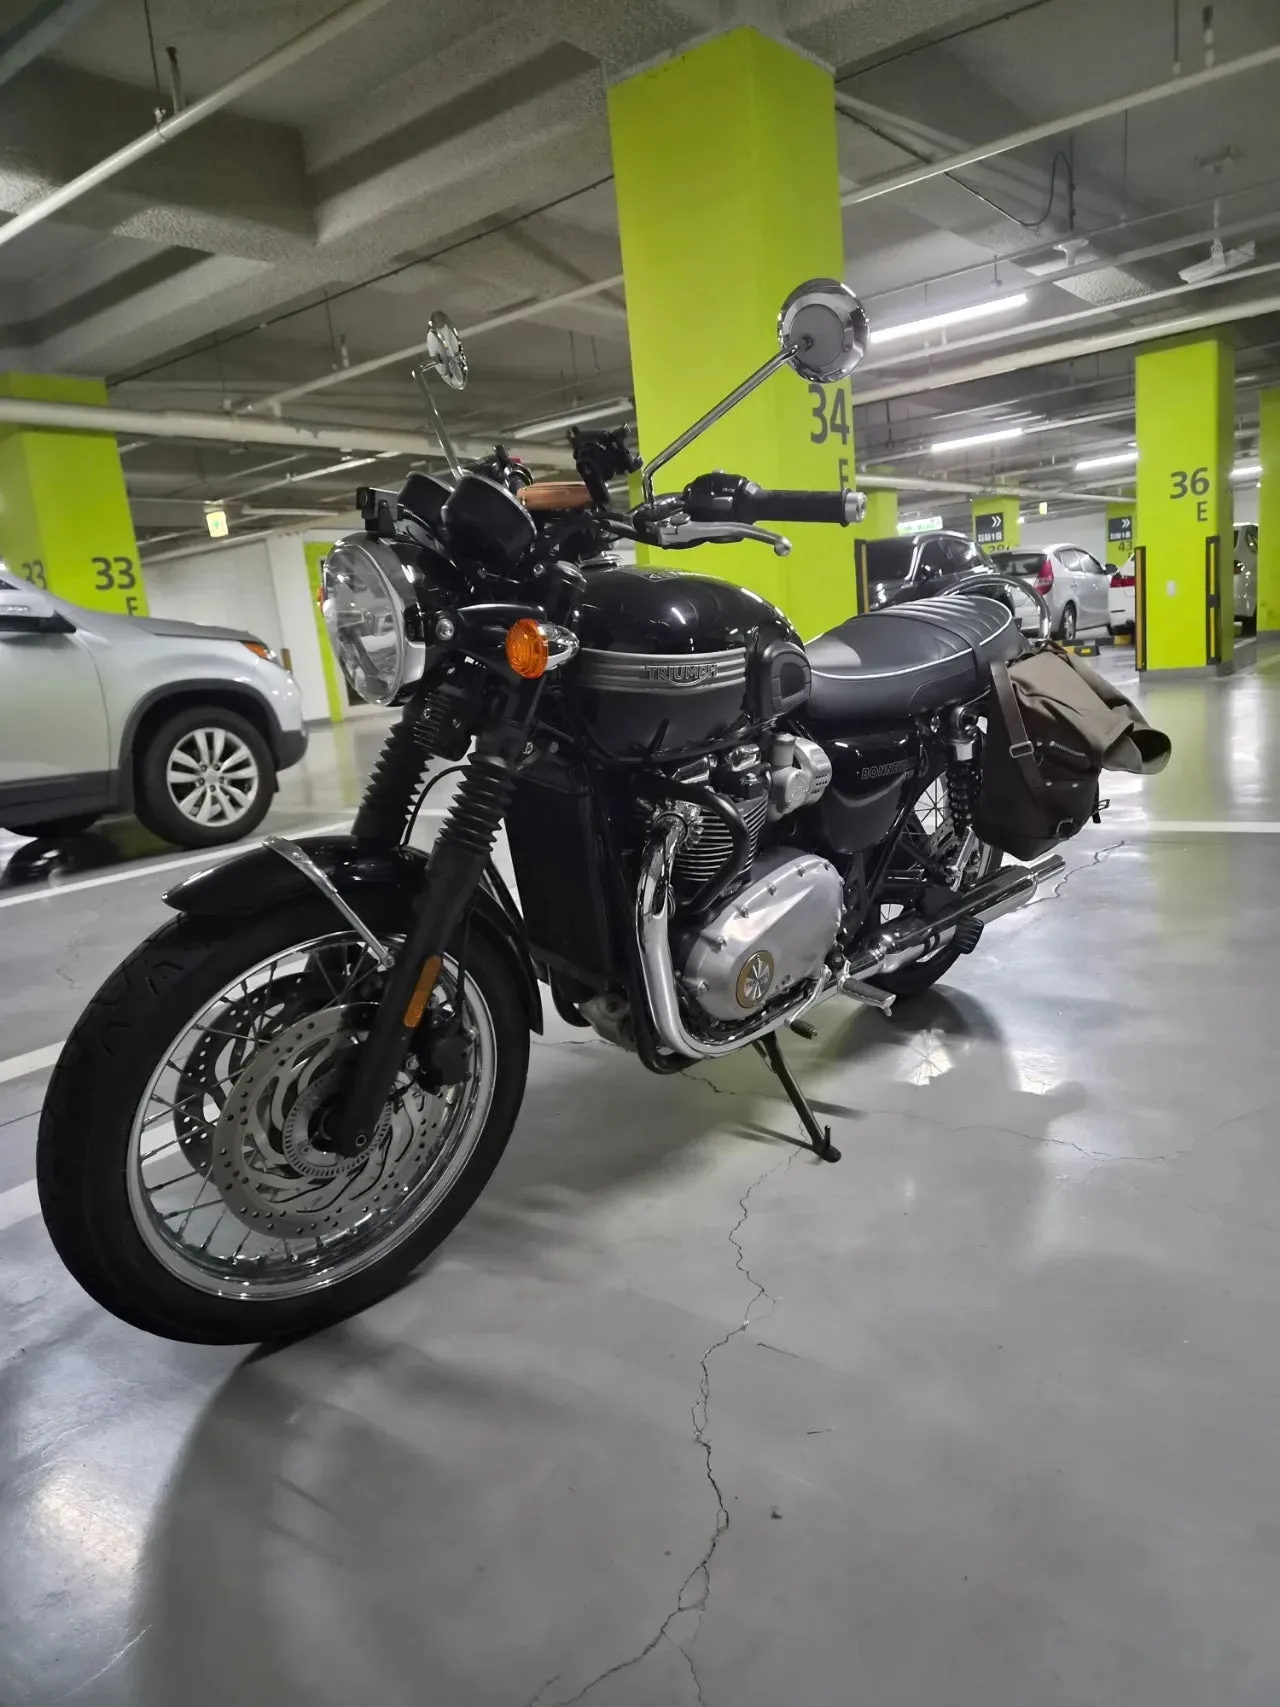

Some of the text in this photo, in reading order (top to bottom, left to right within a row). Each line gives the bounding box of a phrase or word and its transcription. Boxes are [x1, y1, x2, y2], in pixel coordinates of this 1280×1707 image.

[808, 383, 850, 446] 34
[1169, 467, 1210, 500] 36
[1196, 500, 1208, 523] E
[1117, 540, 1133, 553] 43
[91, 556, 137, 591] 33
[646, 661, 719, 687] TRIUMPH
